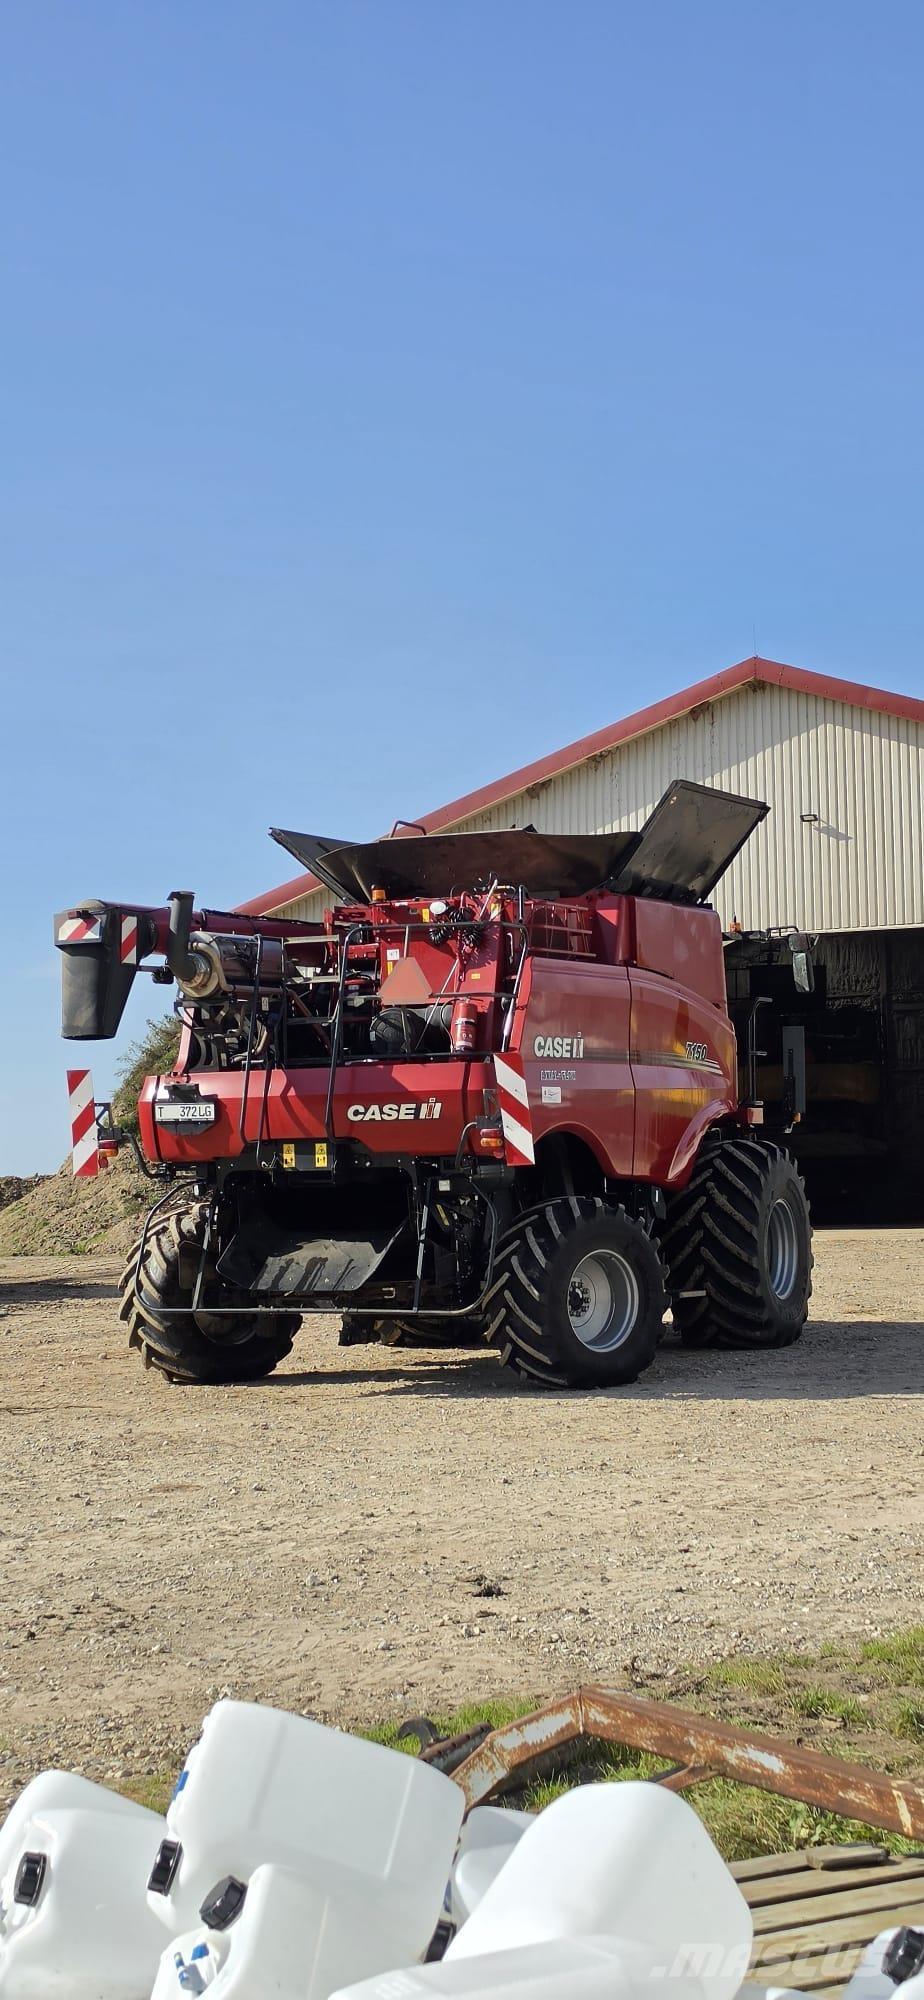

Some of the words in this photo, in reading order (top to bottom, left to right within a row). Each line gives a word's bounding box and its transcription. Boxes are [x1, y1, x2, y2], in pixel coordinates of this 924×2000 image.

[534, 1036, 571, 1058] CASE
[686, 1042, 708, 1061] 7150
[158, 1107, 164, 1117] T
[347, 1104, 416, 1121] CASE
